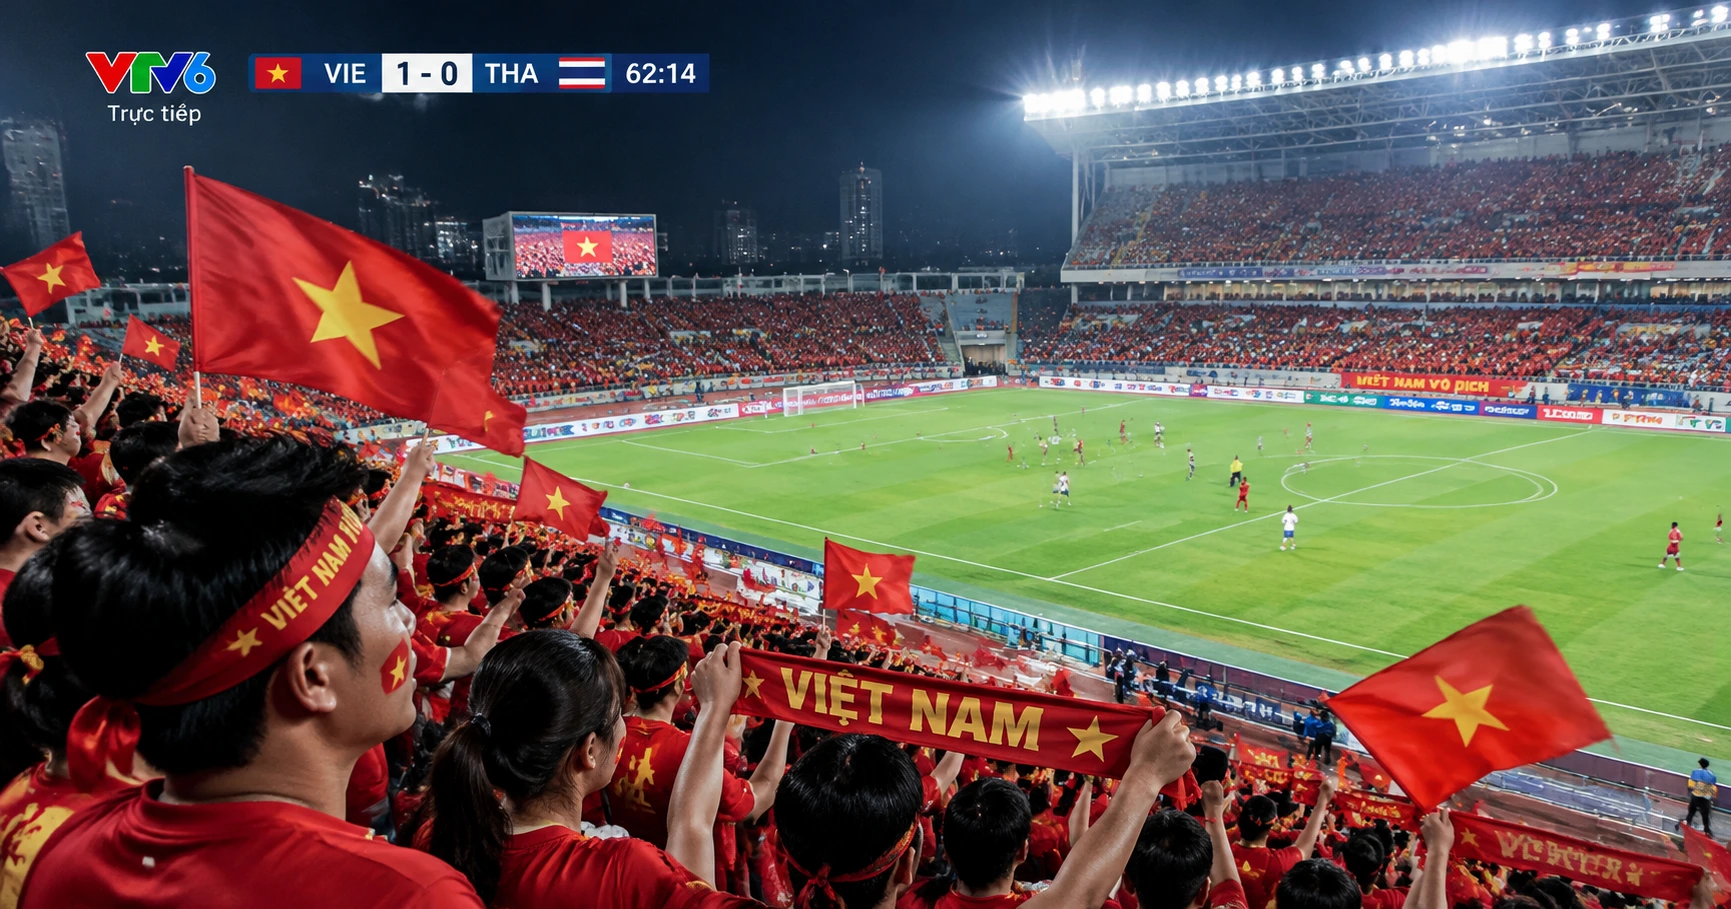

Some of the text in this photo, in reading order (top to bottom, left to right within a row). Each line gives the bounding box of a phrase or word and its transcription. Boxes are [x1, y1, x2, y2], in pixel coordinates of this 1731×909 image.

[1394, 376, 1426, 389] NAM
[311, 533, 352, 587] NAM
[780, 668, 1045, 752] VIỆT NAM
